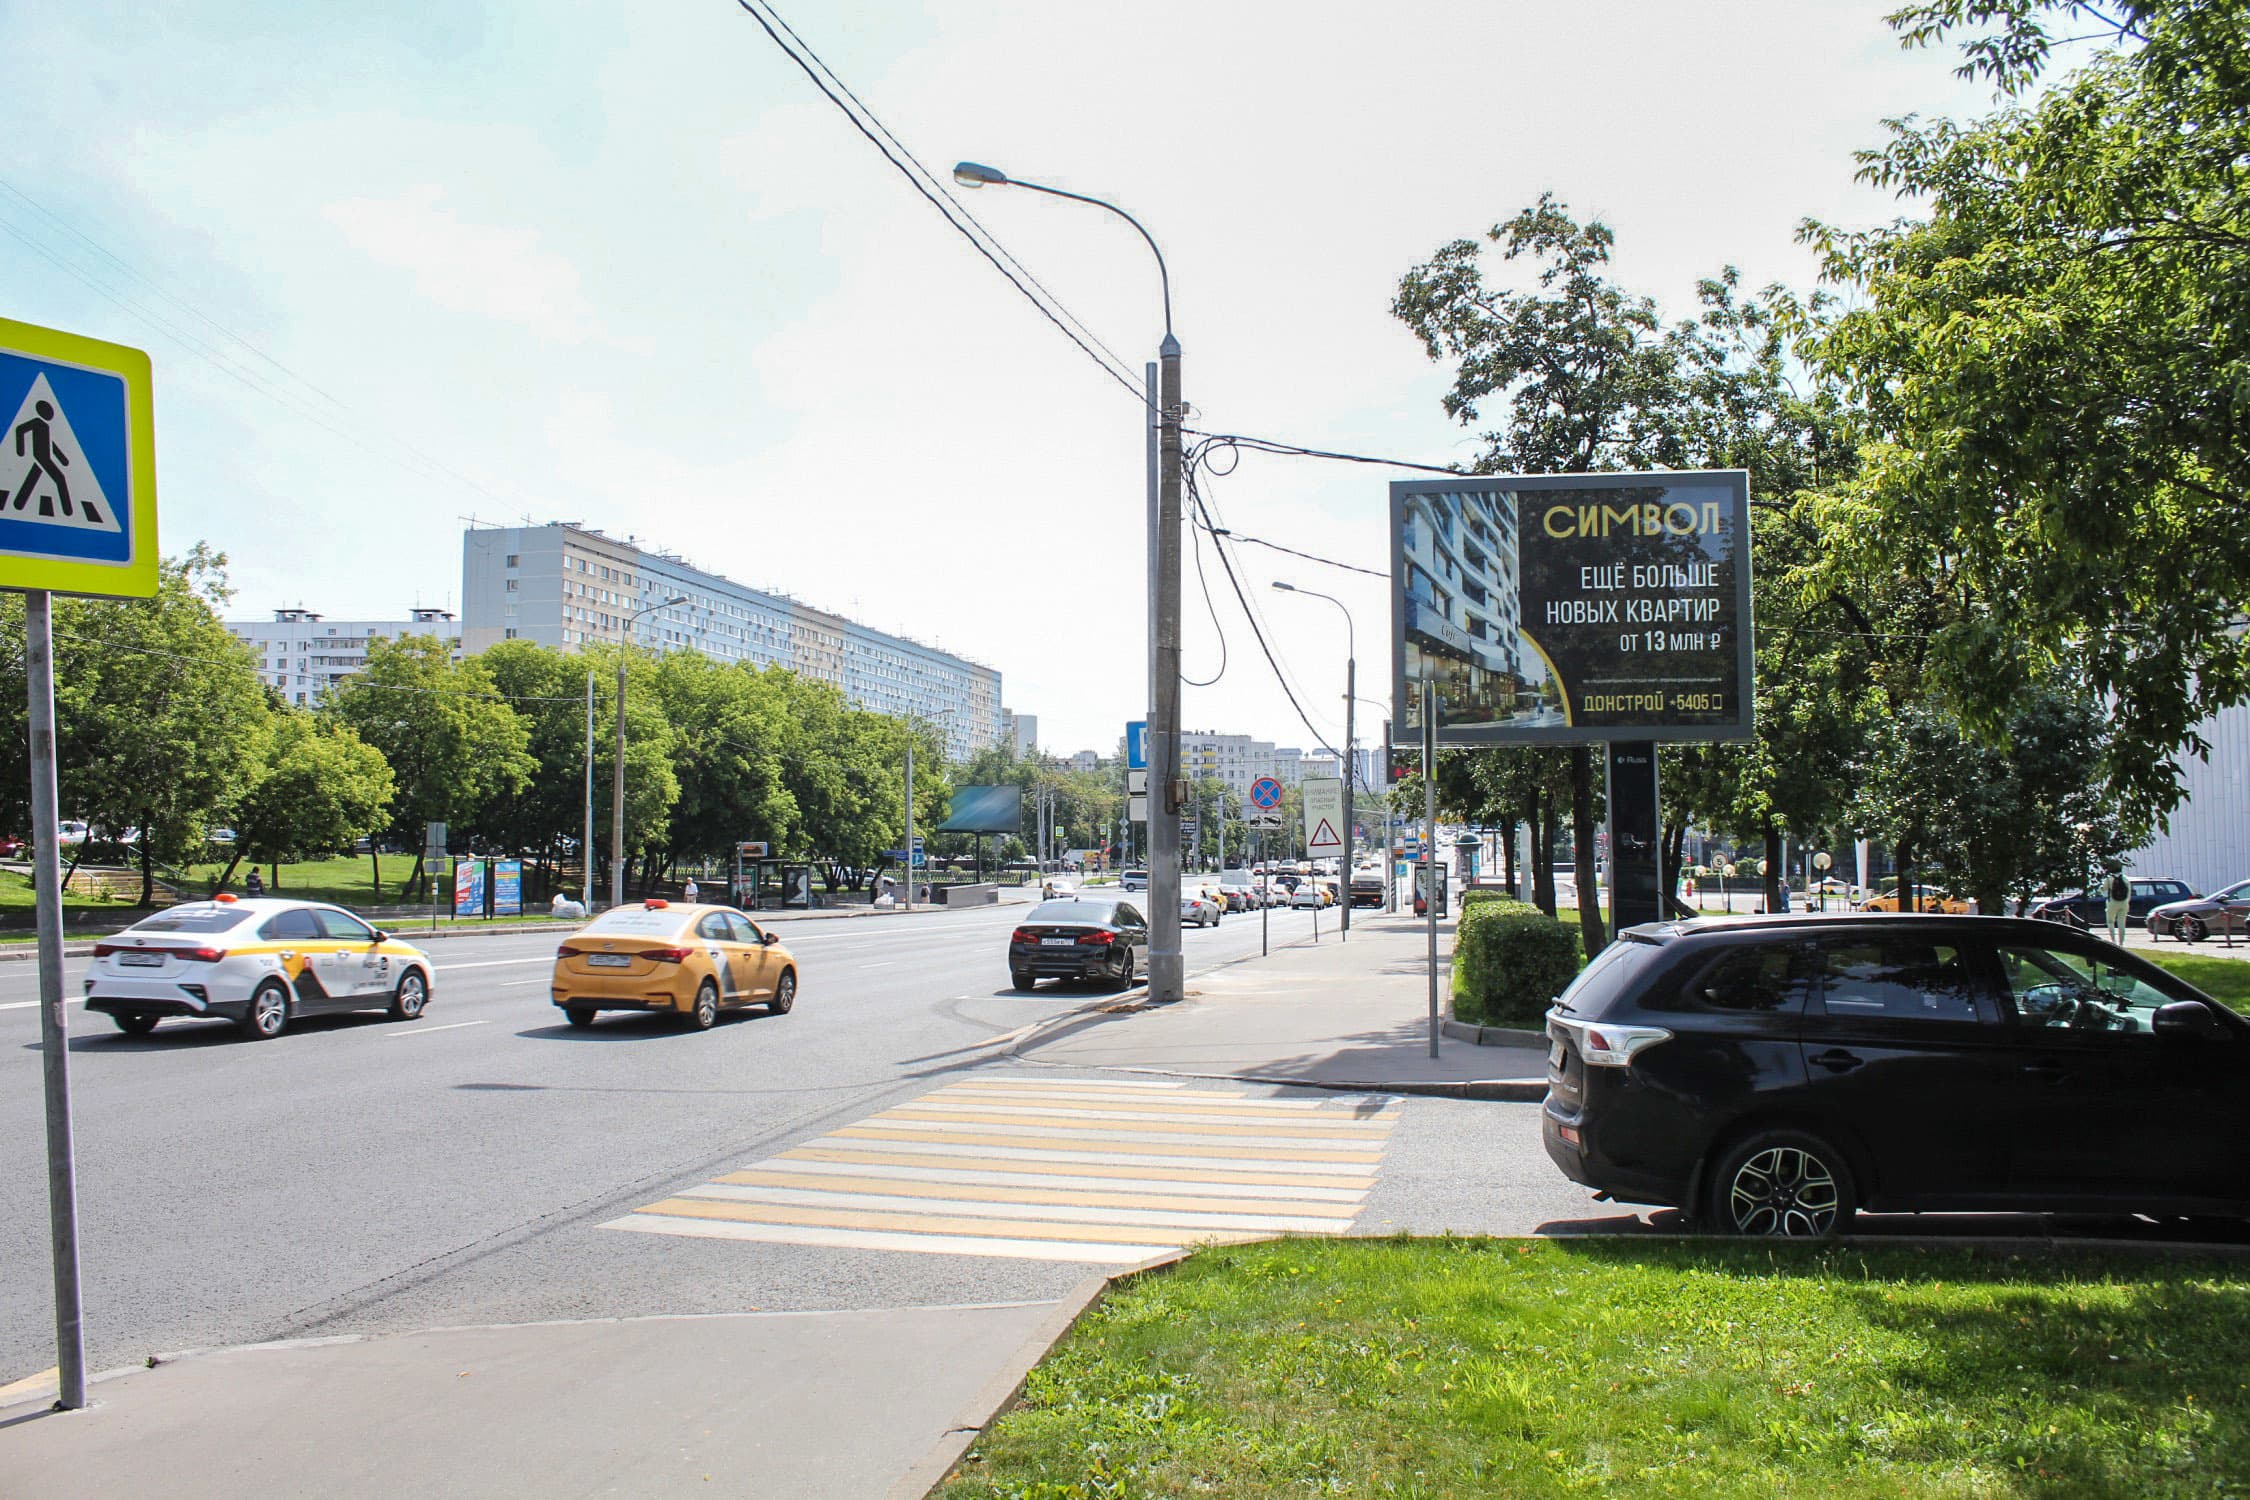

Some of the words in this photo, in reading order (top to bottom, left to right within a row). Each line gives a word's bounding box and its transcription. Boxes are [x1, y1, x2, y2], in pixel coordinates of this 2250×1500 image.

[1543, 502, 1720, 538] СИМВОЛ
[1580, 561, 1626, 592] ЕЩЁ
[1633, 563, 1720, 588] БОЛЬШЕ
[1546, 599, 1619, 625] НОВЫХ
[1626, 598, 1721, 623] КВАРТИР
[1644, 630, 1665, 651] 13
[1583, 690, 1664, 712] ДОНСТРОЙ
